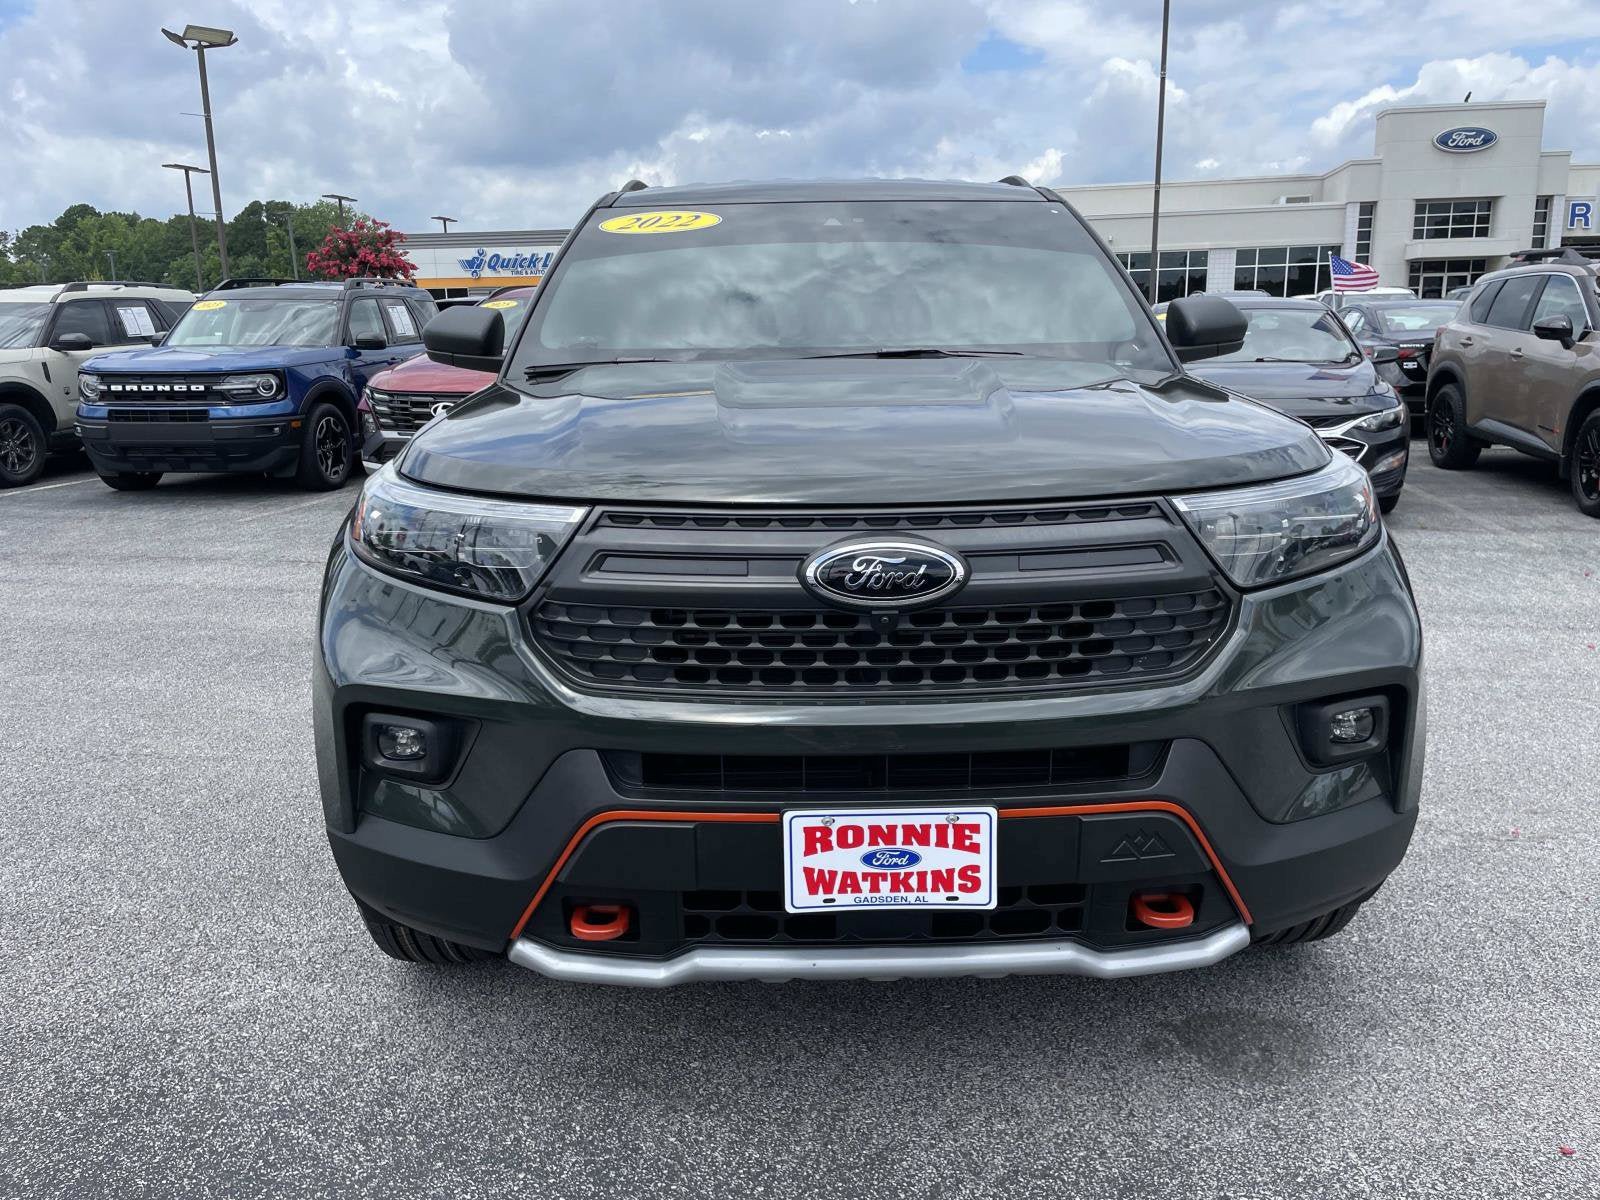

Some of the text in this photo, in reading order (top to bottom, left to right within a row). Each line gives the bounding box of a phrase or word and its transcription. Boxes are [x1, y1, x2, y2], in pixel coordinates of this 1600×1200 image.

[1448, 131, 1485, 147] Ford
[615, 215, 702, 230] 2022
[1568, 201, 1592, 228] R
[487, 253, 541, 272] Quick
[844, 555, 927, 590] Ford
[803, 823, 981, 857] RONNIE
[872, 851, 909, 866] Ford
[803, 864, 982, 896] WATKINS
[854, 895, 929, 904] GADSDEN, AL
